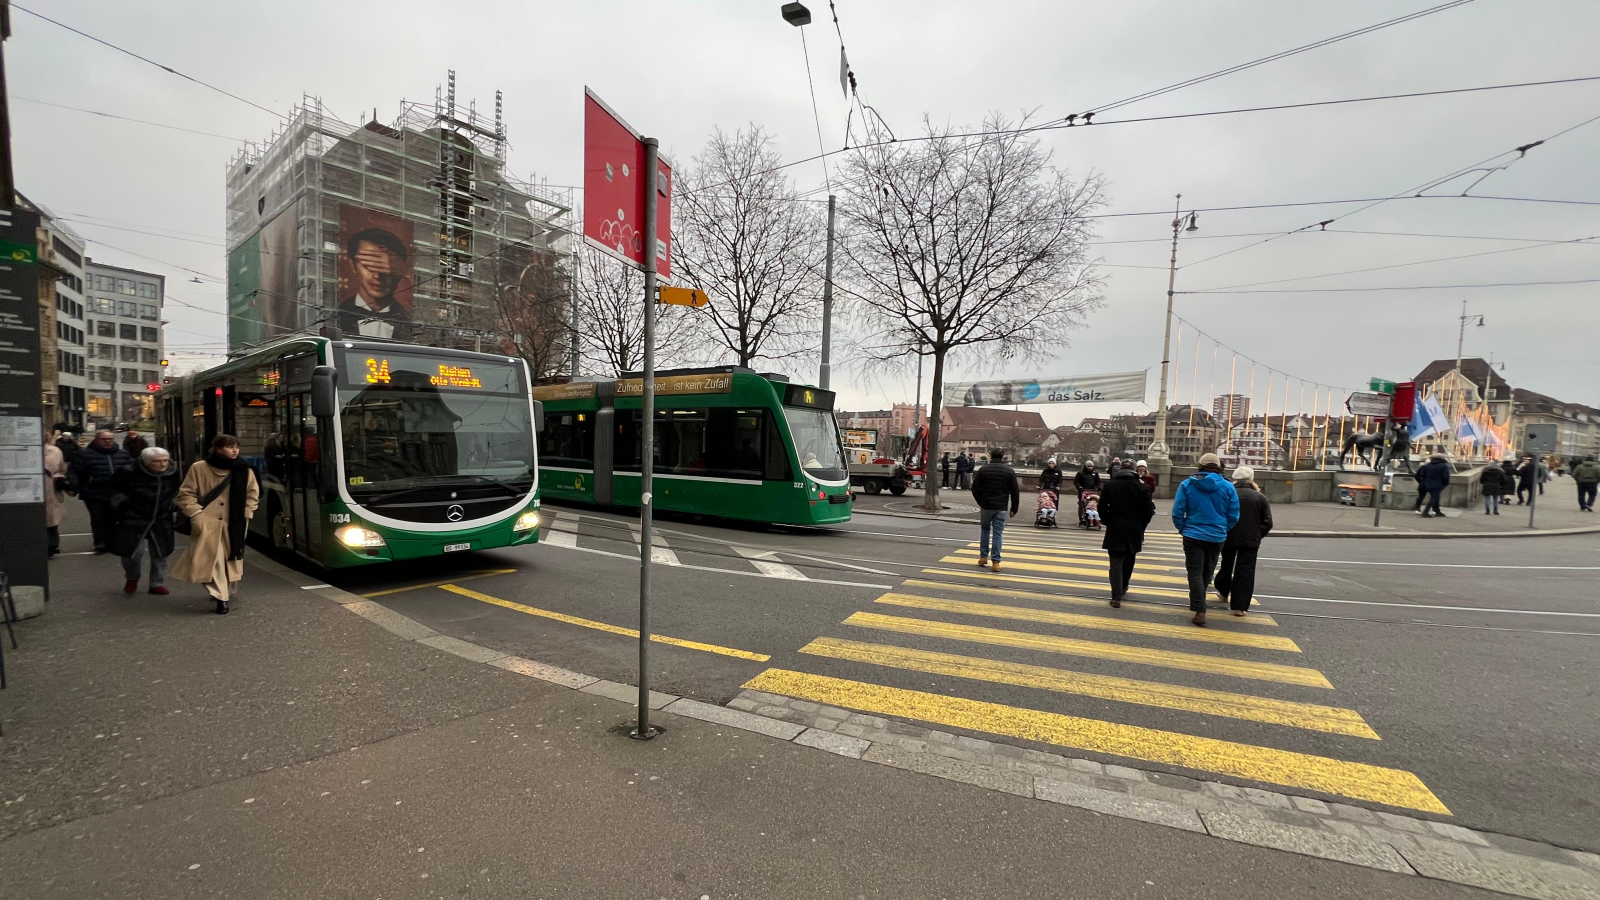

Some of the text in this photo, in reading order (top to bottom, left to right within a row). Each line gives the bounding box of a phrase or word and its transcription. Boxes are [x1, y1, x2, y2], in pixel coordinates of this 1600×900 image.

[366, 358, 391, 384] 34
[439, 364, 472, 378] Riehen
[674, 381, 684, 390] ist
[685, 380, 702, 390] kein
[704, 378, 729, 389] Zufall
[1048, 390, 1105, 402] das Salz.
[329, 513, 351, 523] 7034
